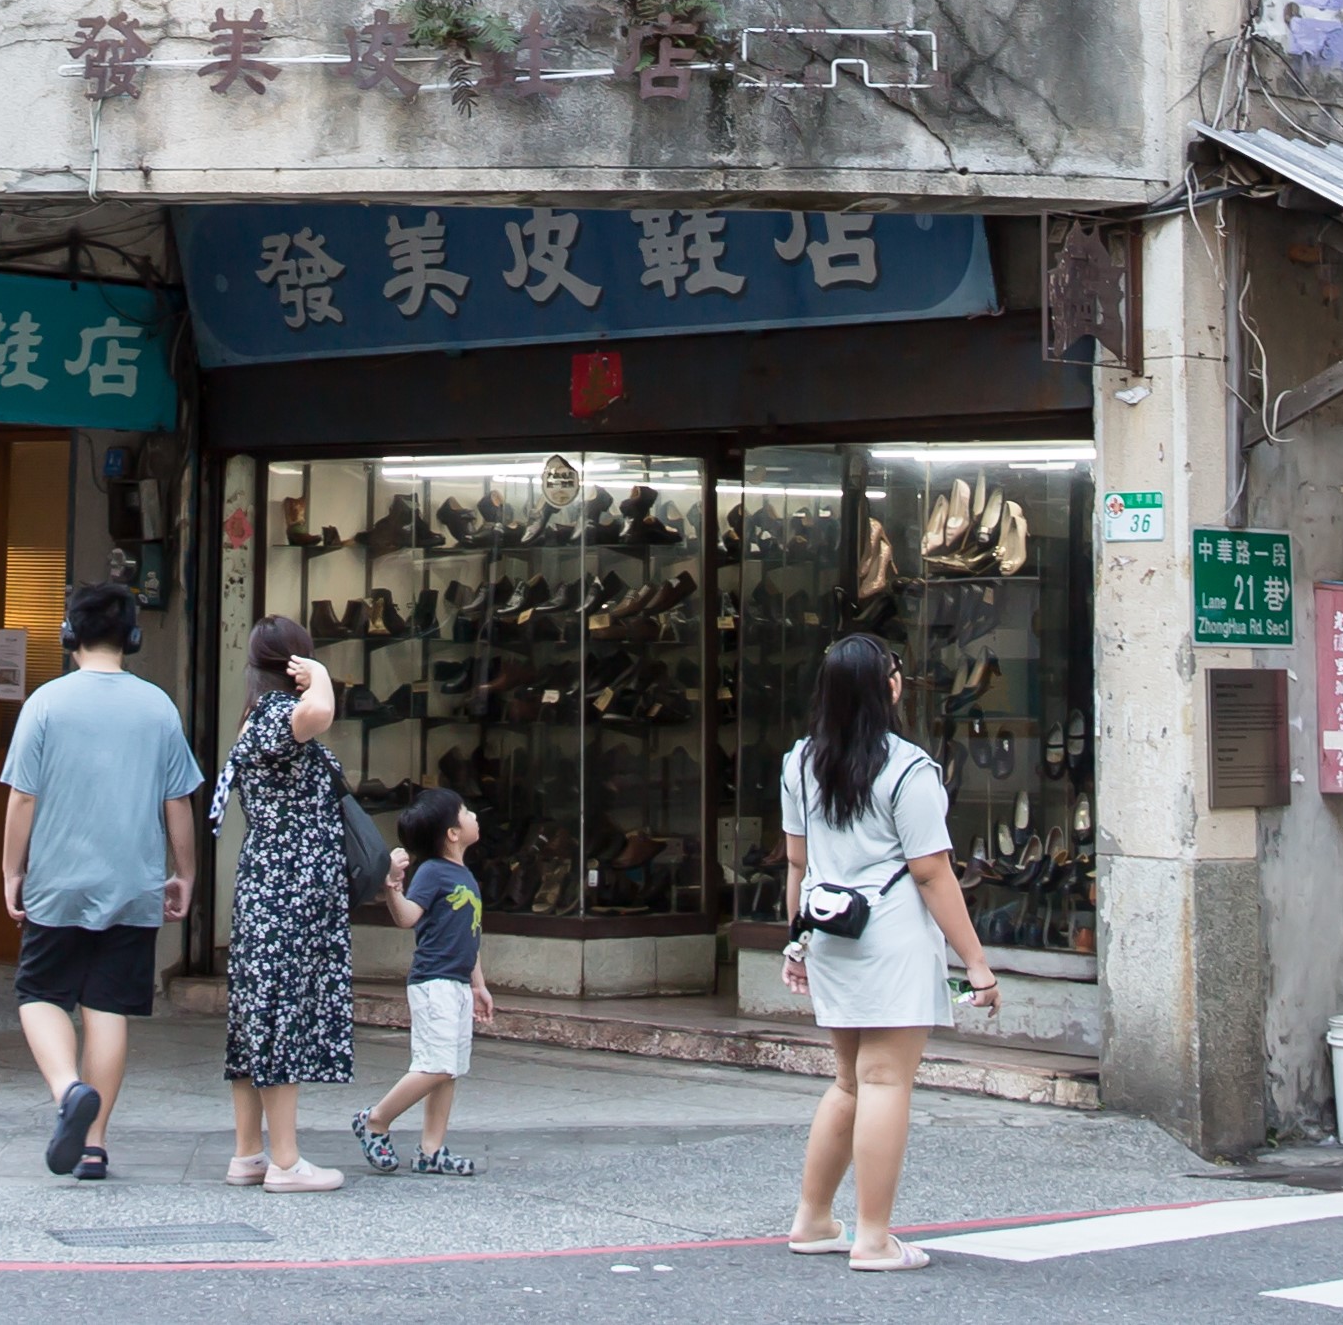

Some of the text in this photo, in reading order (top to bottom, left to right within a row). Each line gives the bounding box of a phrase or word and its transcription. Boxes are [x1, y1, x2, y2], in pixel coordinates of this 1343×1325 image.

[1130, 513, 1151, 533] 36
[1198, 536, 1287, 567] 中華路一段
[1202, 592, 1227, 610] Lane
[1198, 616, 1247, 638] ZhongHua
